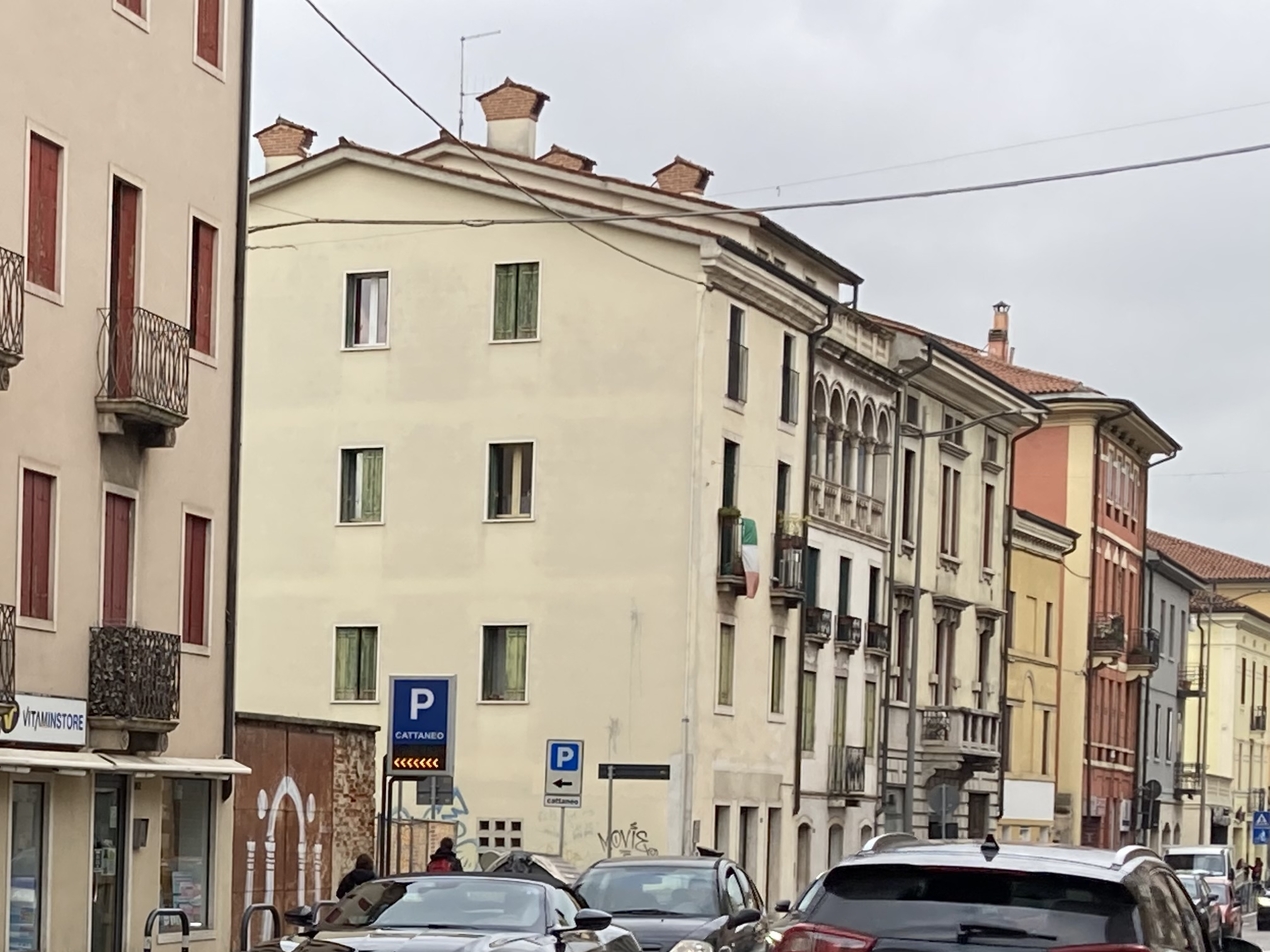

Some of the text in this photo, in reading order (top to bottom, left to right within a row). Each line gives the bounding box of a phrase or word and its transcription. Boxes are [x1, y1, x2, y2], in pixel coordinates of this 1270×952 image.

[410, 688, 435, 720] P
[395, 731, 444, 740] CATTANEO
[556, 746, 574, 768] P
